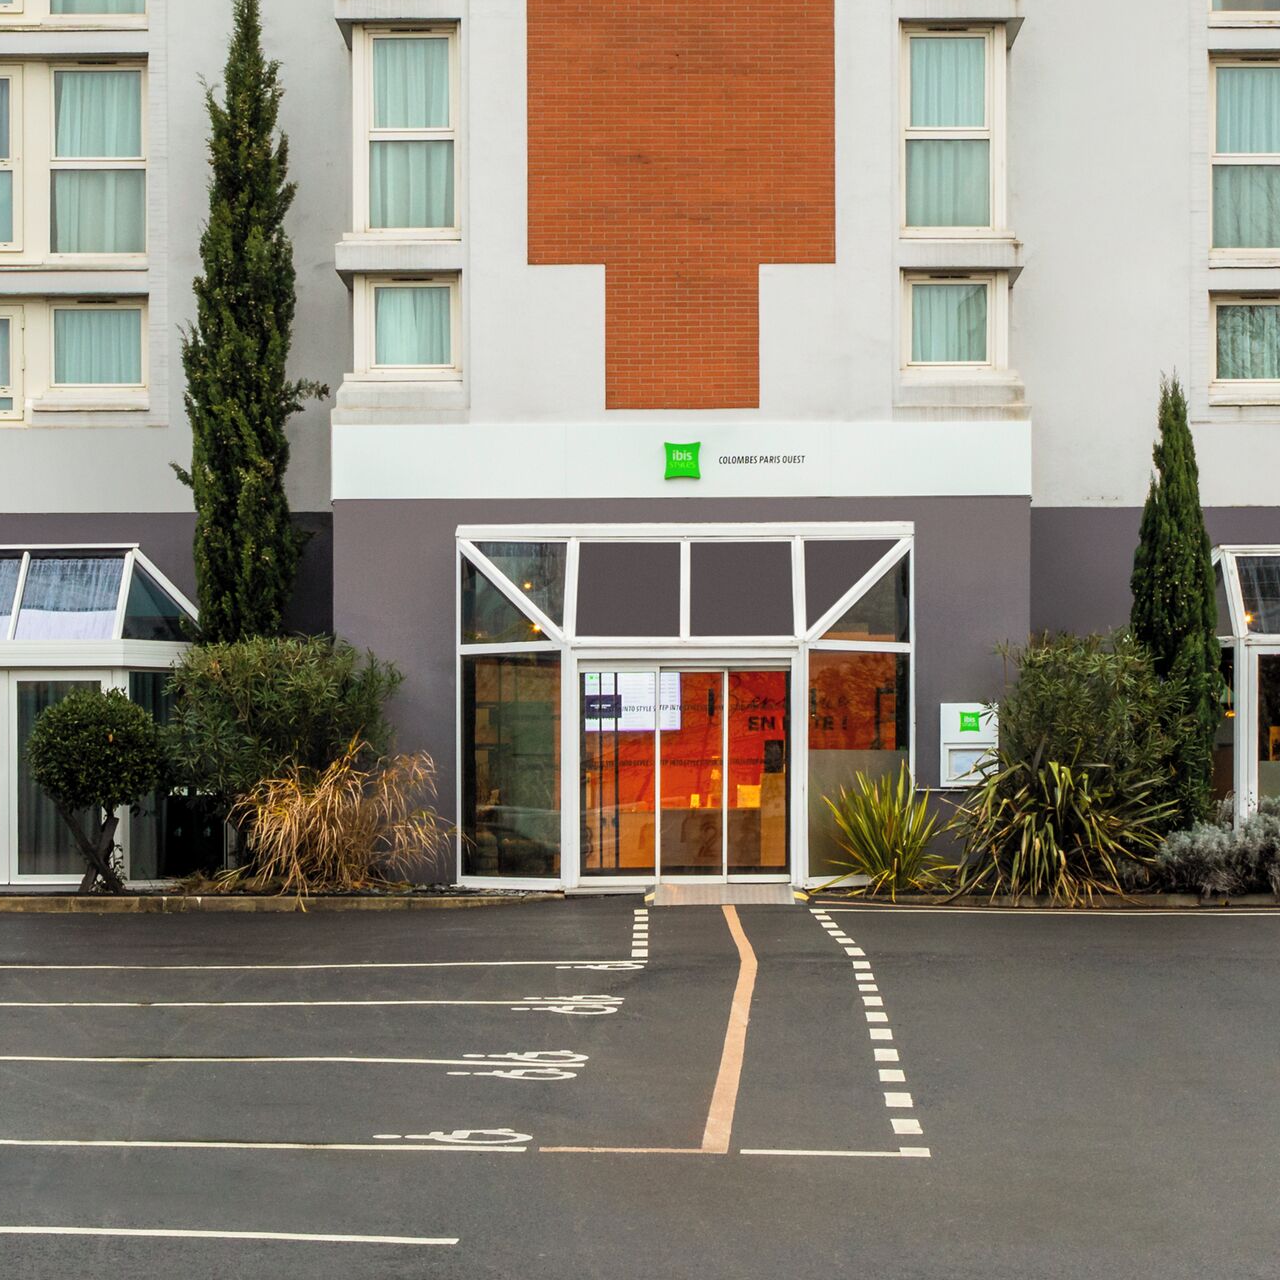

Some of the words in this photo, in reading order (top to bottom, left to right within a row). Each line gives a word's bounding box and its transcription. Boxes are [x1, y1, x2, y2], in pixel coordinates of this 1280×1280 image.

[672, 450, 693, 461] ibis
[719, 455, 758, 465] COLOMBES
[759, 455, 781, 465] PARIS
[782, 455, 806, 464] OUEST
